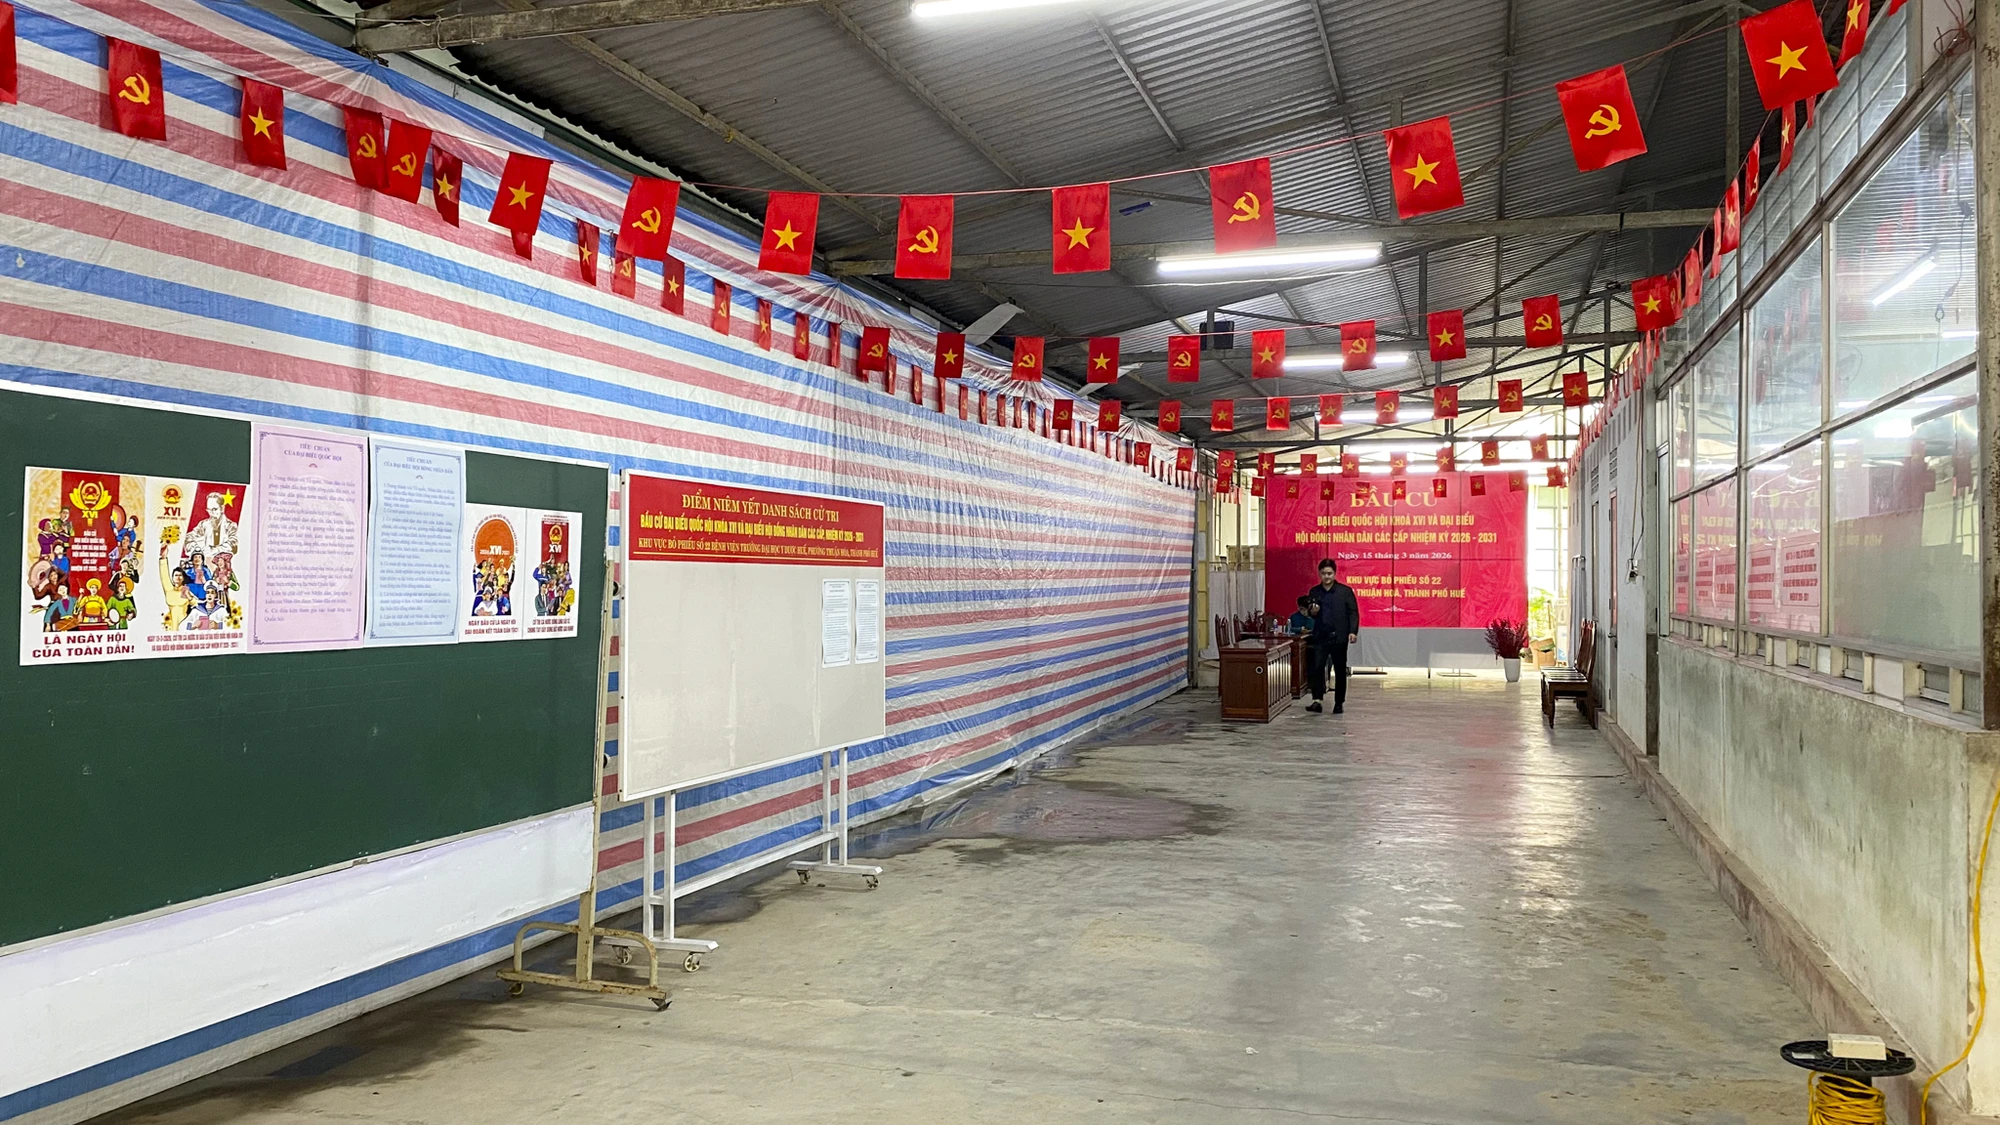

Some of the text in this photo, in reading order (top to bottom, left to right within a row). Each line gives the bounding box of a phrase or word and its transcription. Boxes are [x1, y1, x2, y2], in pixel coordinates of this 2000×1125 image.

[1406, 486, 1438, 507] CỬ
[164, 506, 181, 516] XVI
[682, 488, 839, 522] ĐIỂM NIÊM YẾT DANH SÁCH CỬ TRI
[82, 510, 98, 519] XVI
[1317, 516, 1330, 528] ĐẠI
[1332, 512, 1350, 526] BIỂU
[1352, 512, 1372, 528] QUỐC
[1374, 514, 1388, 528] HỘI
[1412, 515, 1426, 526] XVI
[1428, 513, 1438, 526] VÀ
[1440, 514, 1454, 528] ĐẠI
[1456, 511, 1474, 526] BIỂU
[654, 511, 664, 529] CỬ
[664, 516, 674, 532] ĐẠI
[674, 512, 688, 531] BIỂU
[689, 514, 704, 533] QUỐC
[704, 516, 714, 535] HỘI
[1295, 530, 1308, 545] HỘI
[1332, 530, 1355, 543] NHÂN
[1356, 530, 1372, 543] DÂN
[1374, 530, 1391, 543] CÁC
[1392, 529, 1408, 543] CẤP
[1410, 530, 1437, 545] NHIỆM
[1438, 530, 1450, 543] KỲ
[1451, 532, 1471, 543] 2026
[1478, 532, 1497, 543] 2031
[490, 546, 502, 556] XVI
[548, 544, 562, 553] XVI
[638, 538, 652, 548] KHU
[654, 538, 668, 551] VỰC
[668, 536, 677, 549] BỎ
[678, 536, 695, 550] PHIẾU
[696, 537, 704, 550] SỐ
[711, 540, 726, 553] BỆNH
[726, 540, 740, 554] VIỆN
[1338, 552, 1360, 560] Ngày
[1374, 552, 1400, 560] tháng
[1346, 574, 1442, 586] KHU VỰC BỎ PHIẾU SỐ 22
[1357, 588, 1382, 599] THUẬN
[1404, 587, 1430, 598] THÀNH
[1432, 586, 1448, 598] PHỐ
[1450, 586, 1466, 598] HUẾ
[44, 632, 126, 645] LÀ NGÀY HỘI
[32, 643, 135, 658] CỦA TOÀN DÂN!
